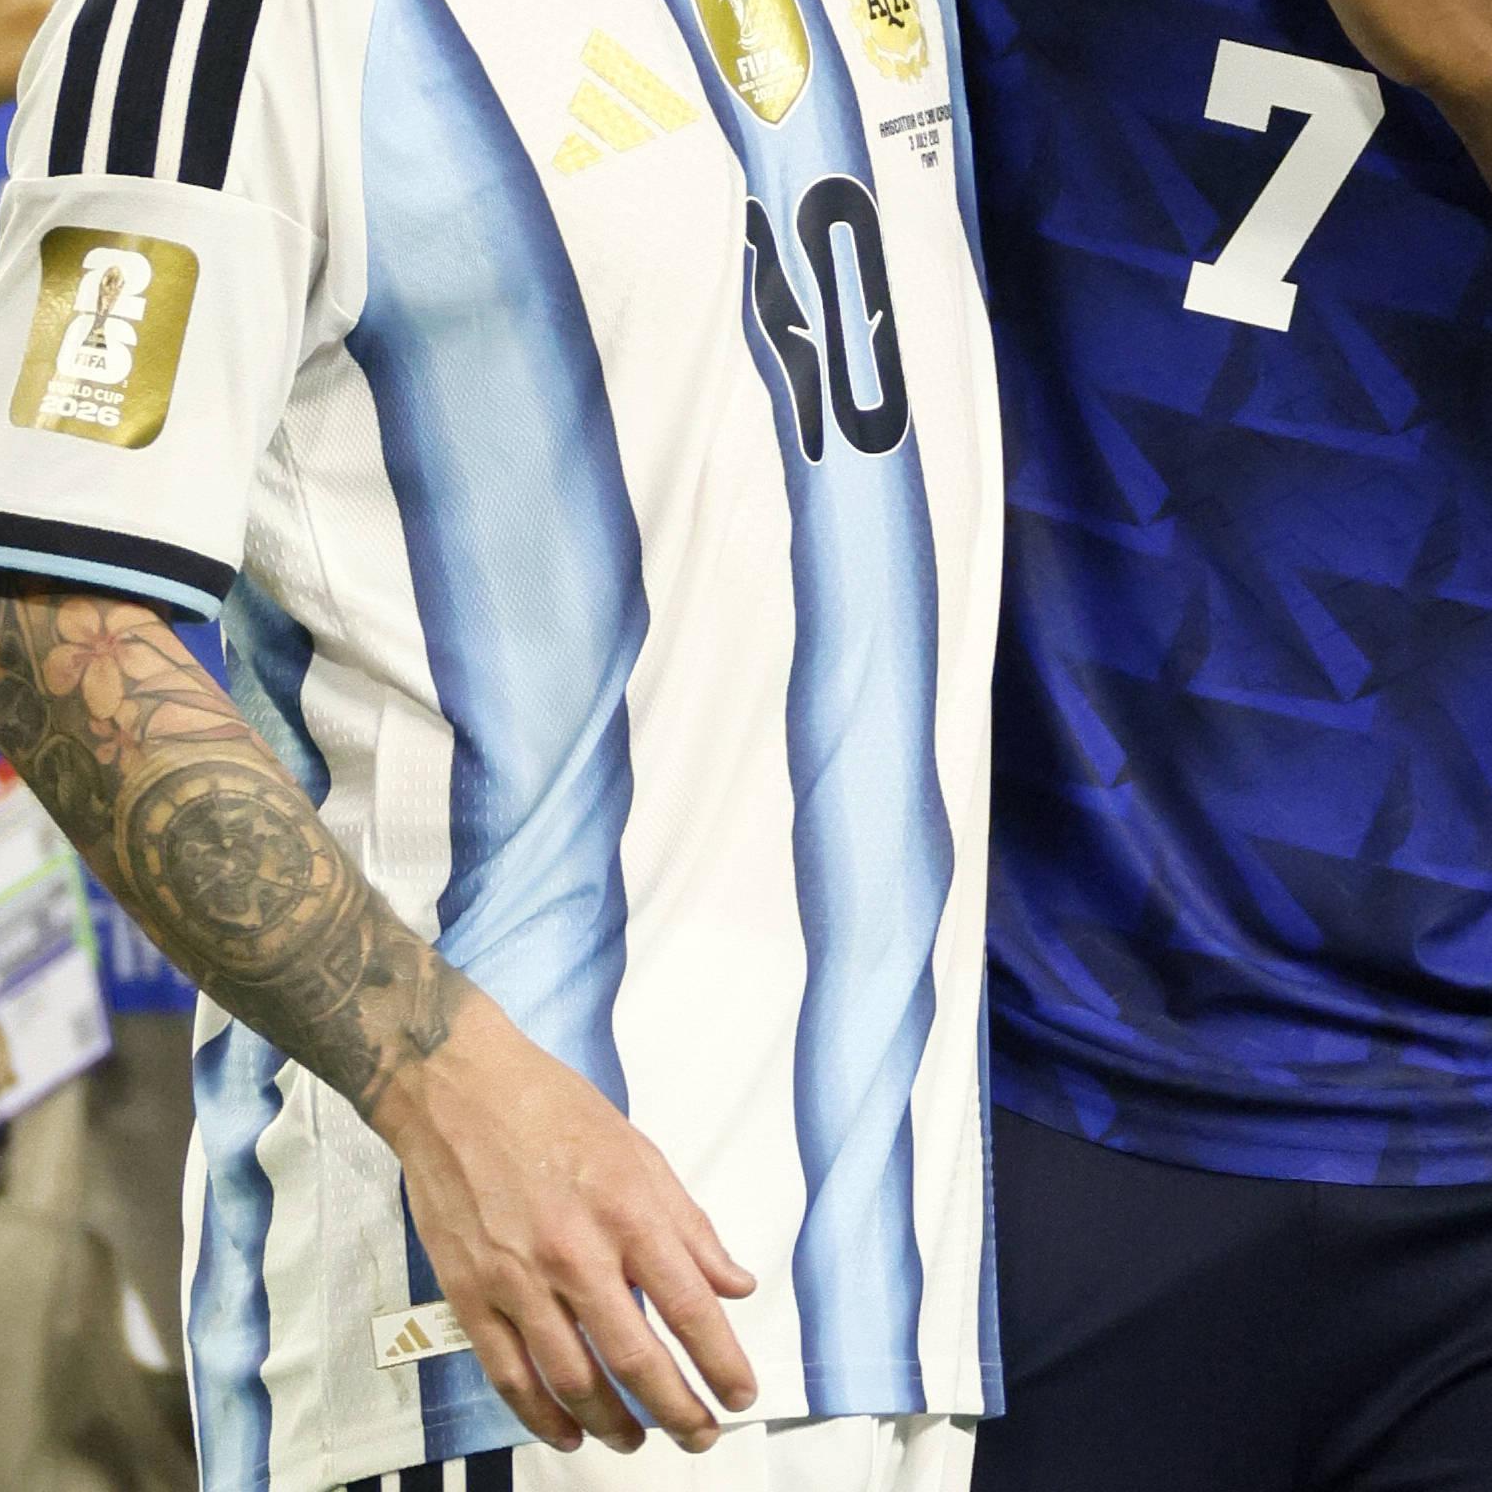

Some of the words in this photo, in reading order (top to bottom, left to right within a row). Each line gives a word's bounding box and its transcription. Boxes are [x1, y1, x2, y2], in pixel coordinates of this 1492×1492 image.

[1183, 39, 1386, 332] 7
[747, 174, 910, 465] 10
[75, 352, 107, 370] FIFA
[39, 395, 121, 427] 2026
[94, 388, 125, 405] CUP
